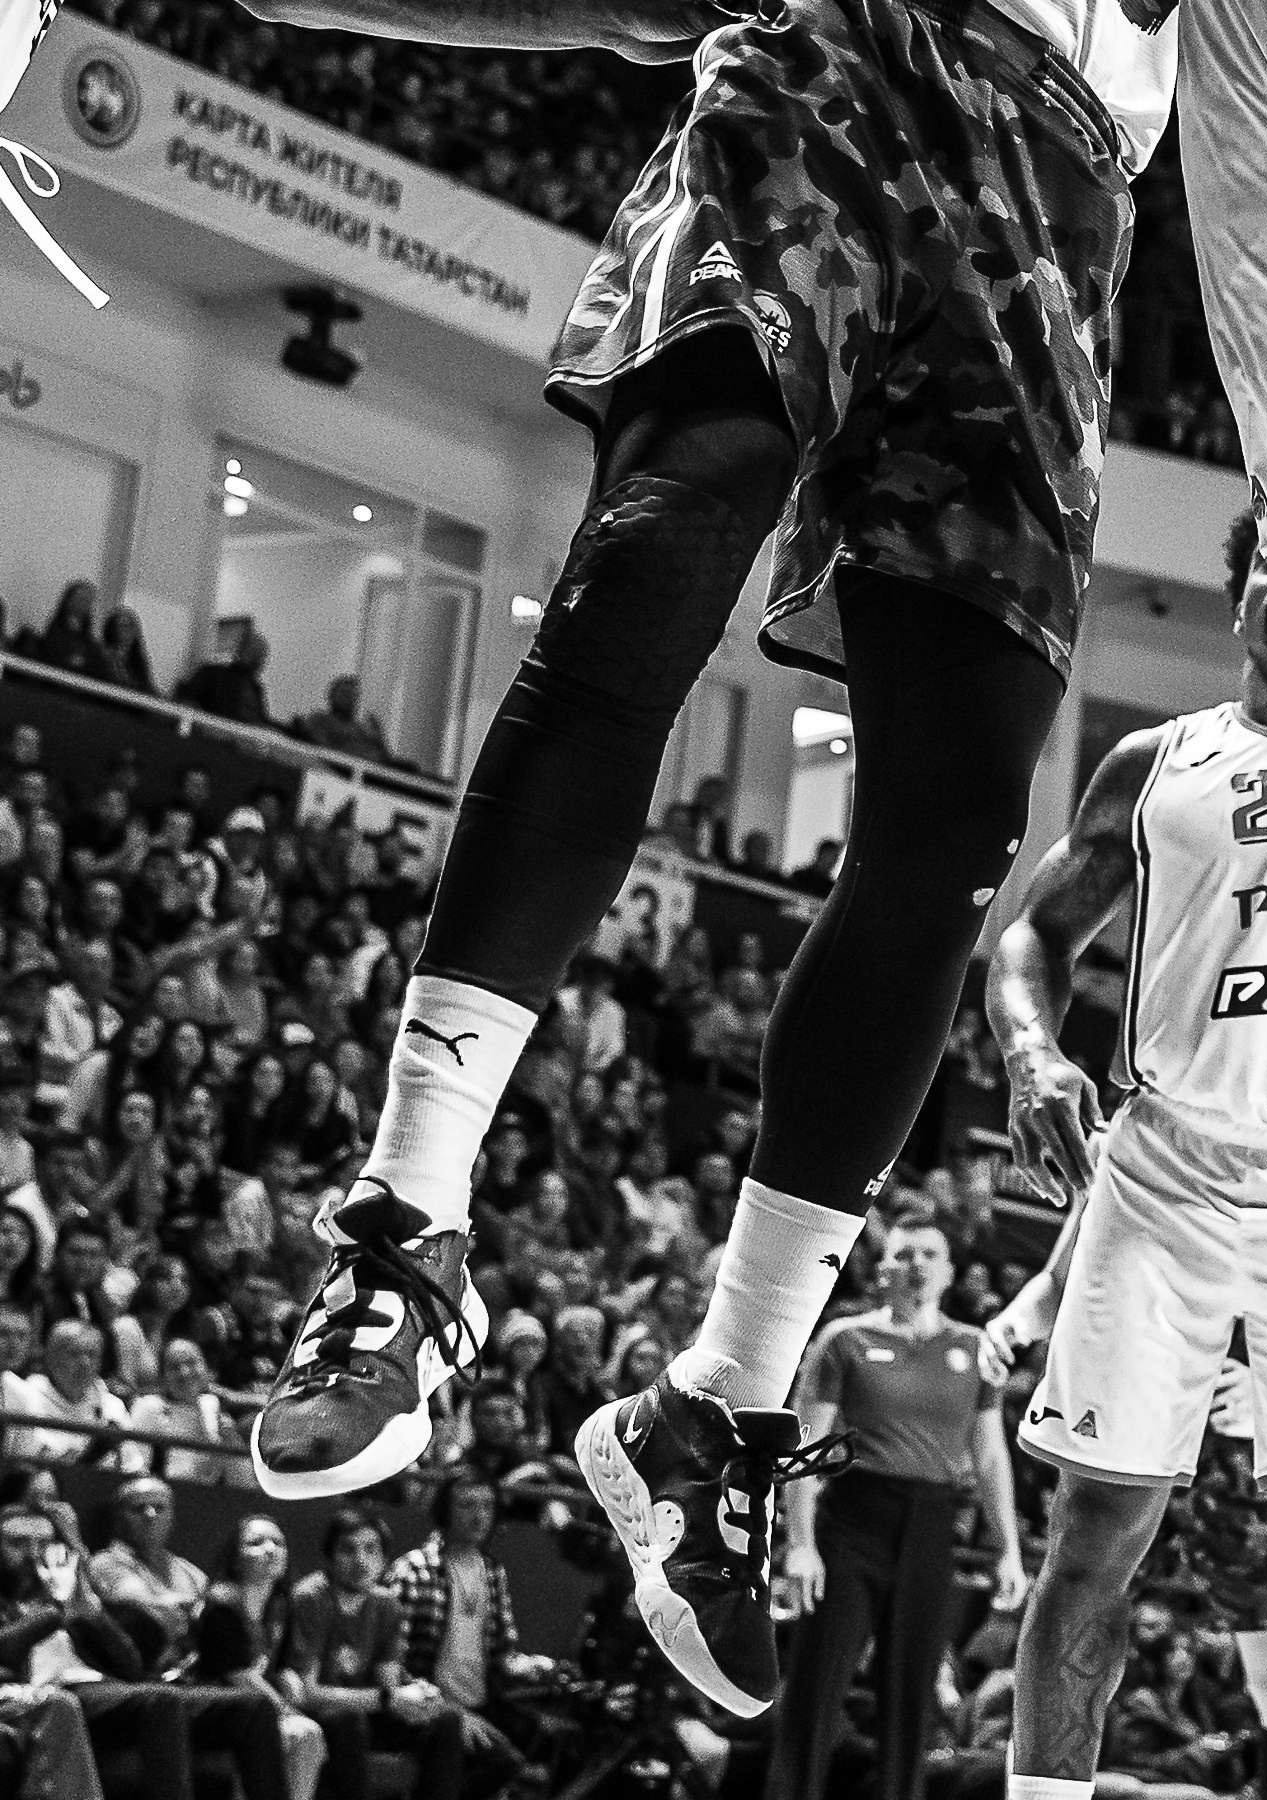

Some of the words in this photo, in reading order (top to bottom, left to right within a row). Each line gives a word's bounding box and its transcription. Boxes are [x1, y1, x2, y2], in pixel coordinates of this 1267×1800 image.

[172, 87, 272, 153] КАРТА
[278, 132, 403, 210] ЖИТЕЛЯ
[165, 135, 370, 250] РЕСПУБЛИКИ
[376, 223, 531, 315] ТАТАРСТАН
[689, 263, 743, 286] PEAK
